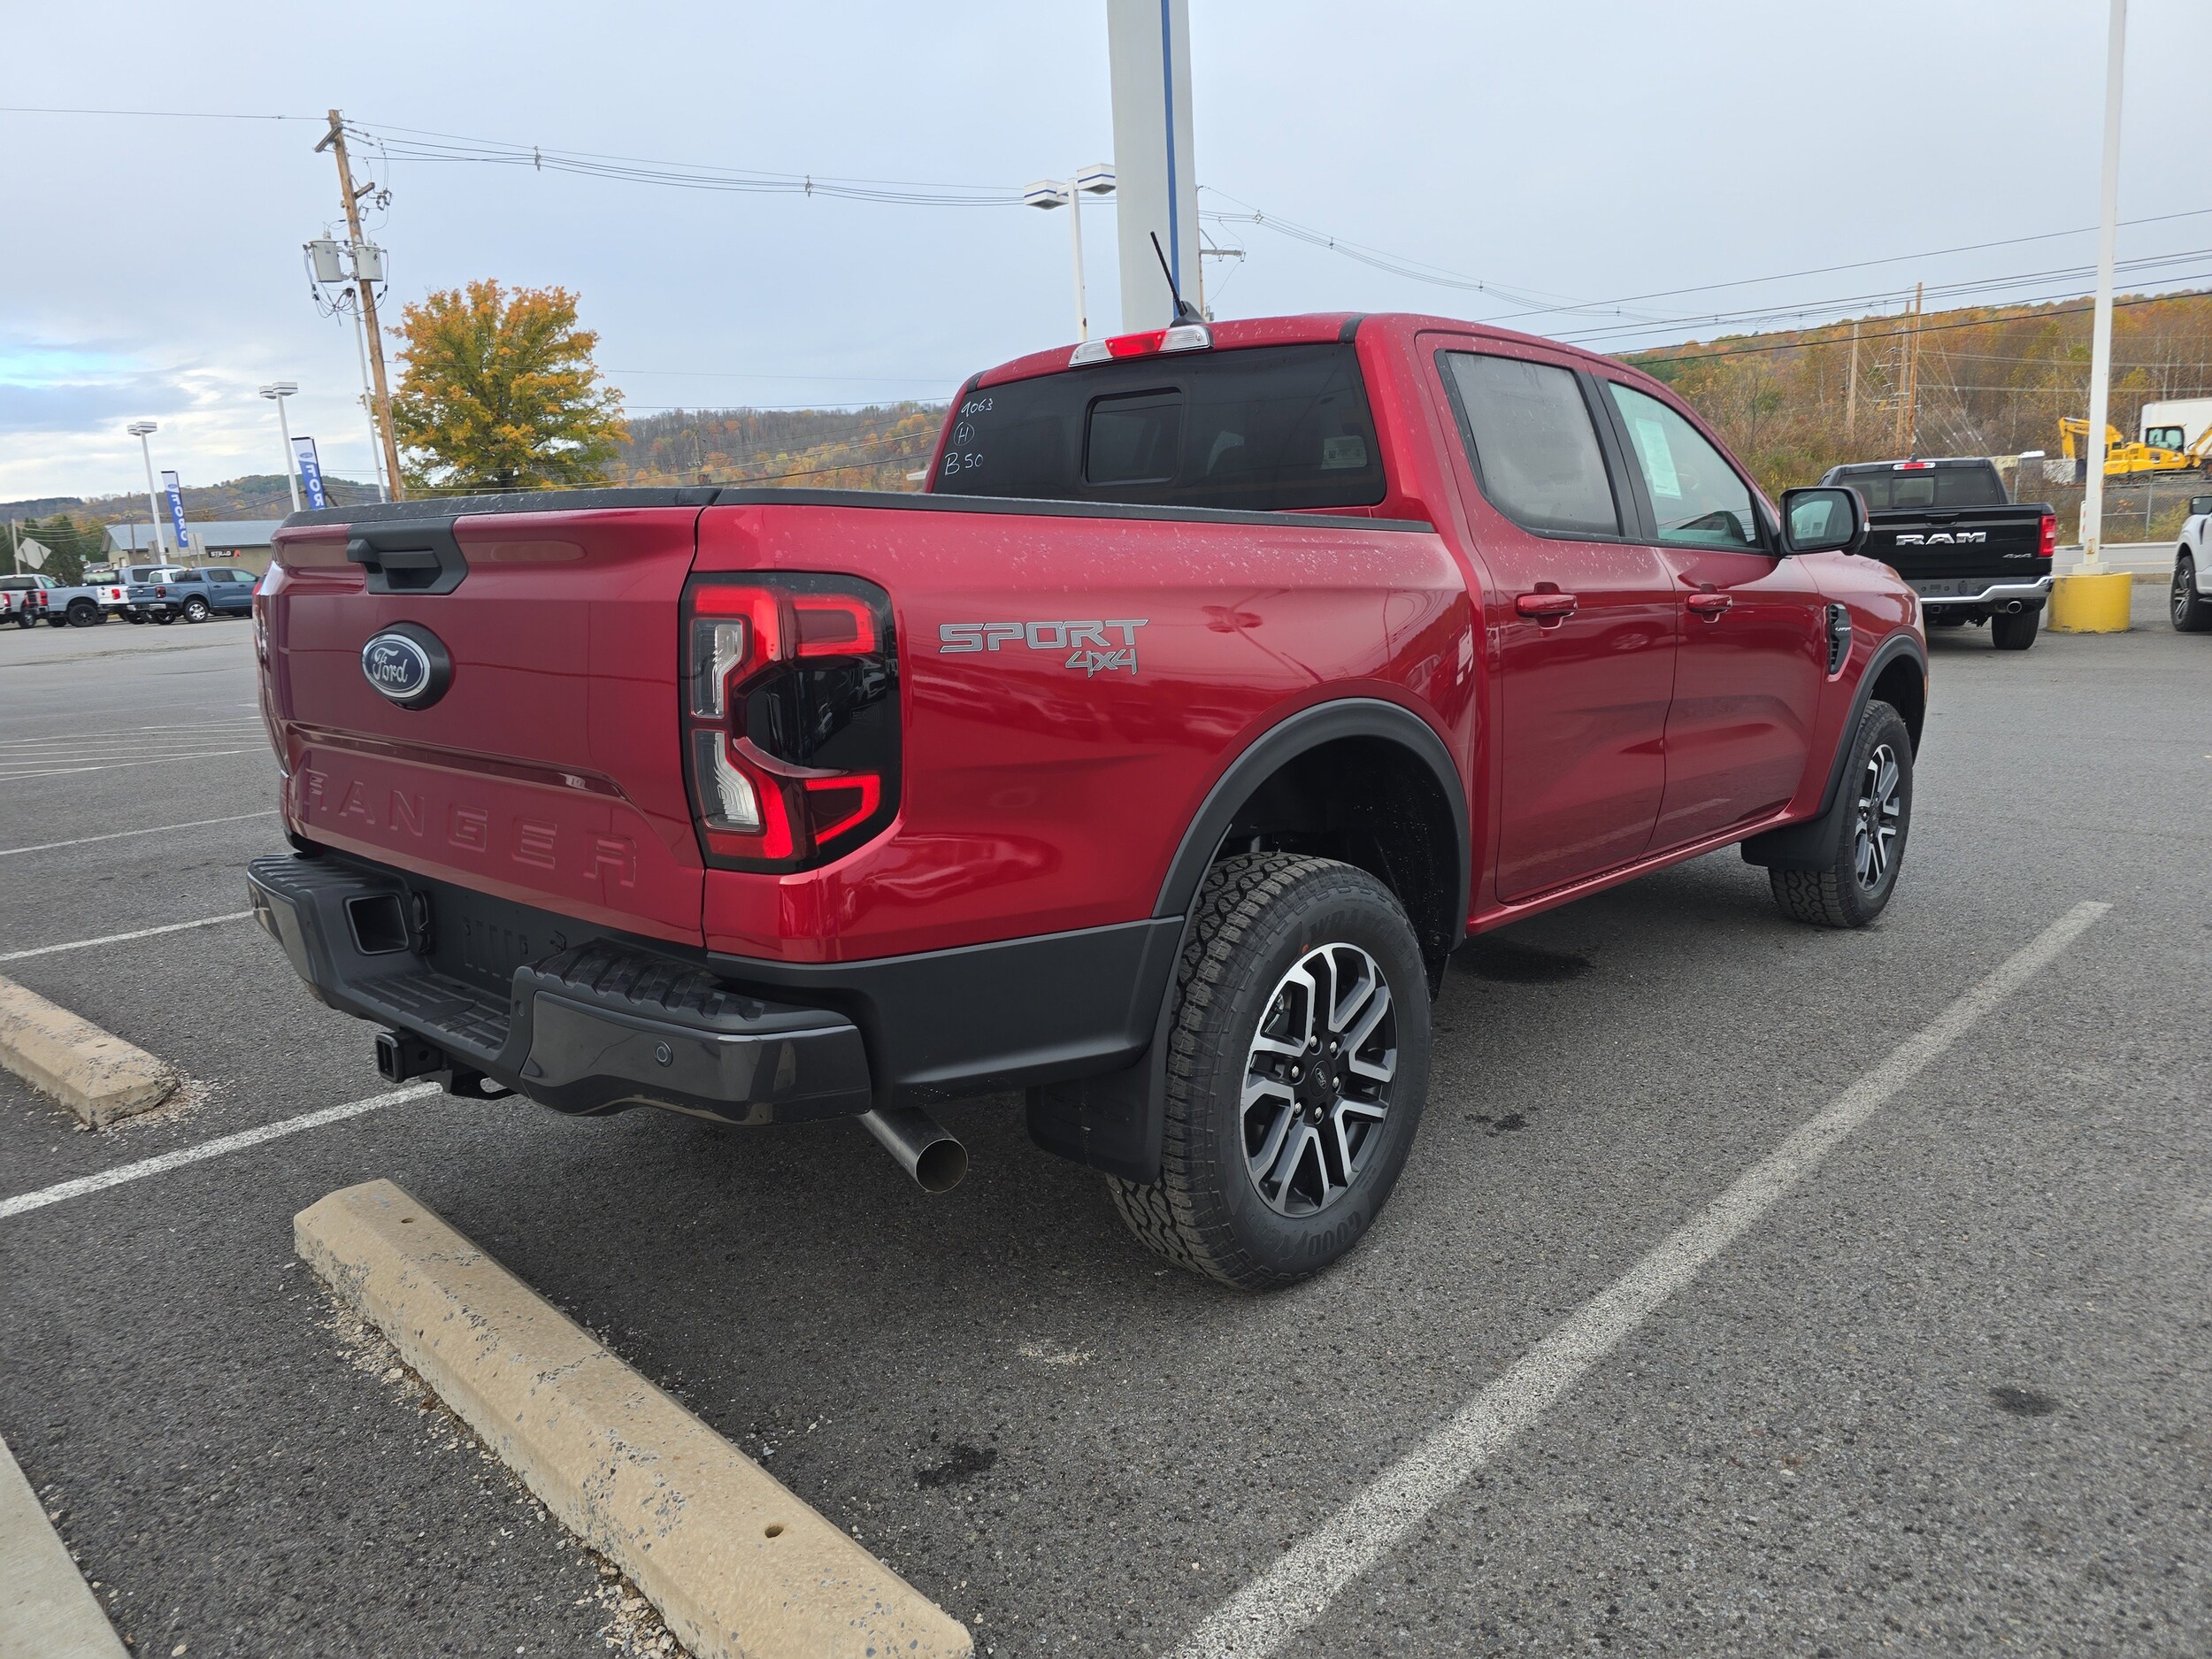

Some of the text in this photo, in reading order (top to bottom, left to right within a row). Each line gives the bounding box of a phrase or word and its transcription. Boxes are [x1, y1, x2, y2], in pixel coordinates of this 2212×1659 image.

[1895, 531, 1987, 546] RAM
[939, 618, 1149, 653] SPORT
[372, 646, 409, 683] Ford
[302, 766, 638, 888] RANGER
